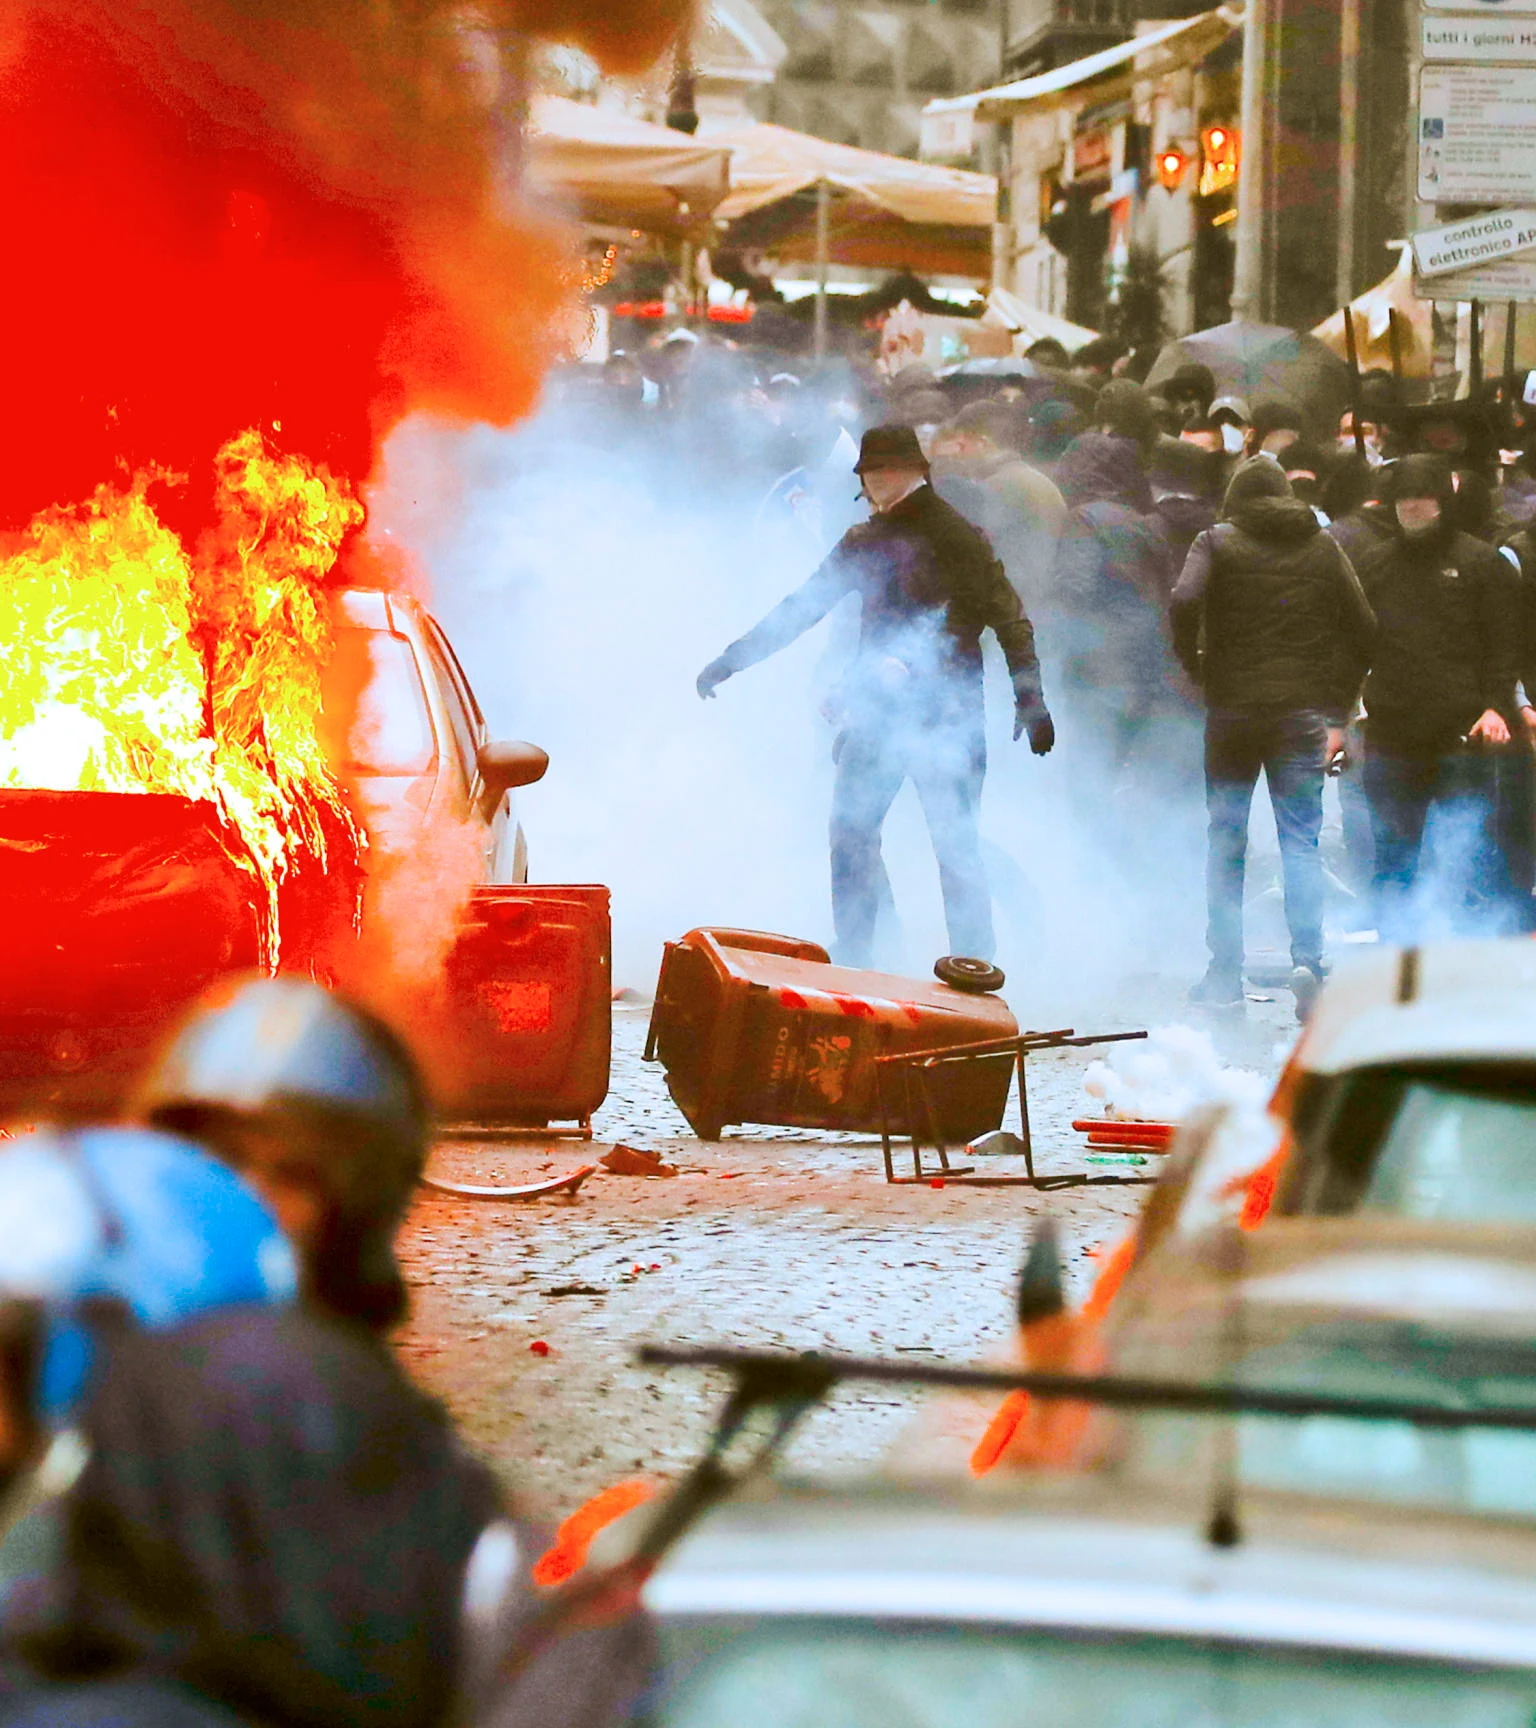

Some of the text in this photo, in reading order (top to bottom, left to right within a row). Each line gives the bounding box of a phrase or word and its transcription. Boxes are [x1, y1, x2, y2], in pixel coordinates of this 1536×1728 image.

[1426, 31, 1458, 44] tutti
[1473, 33, 1515, 47] giorni
[1443, 217, 1513, 245] controllo
[1429, 238, 1512, 266] elettronico
